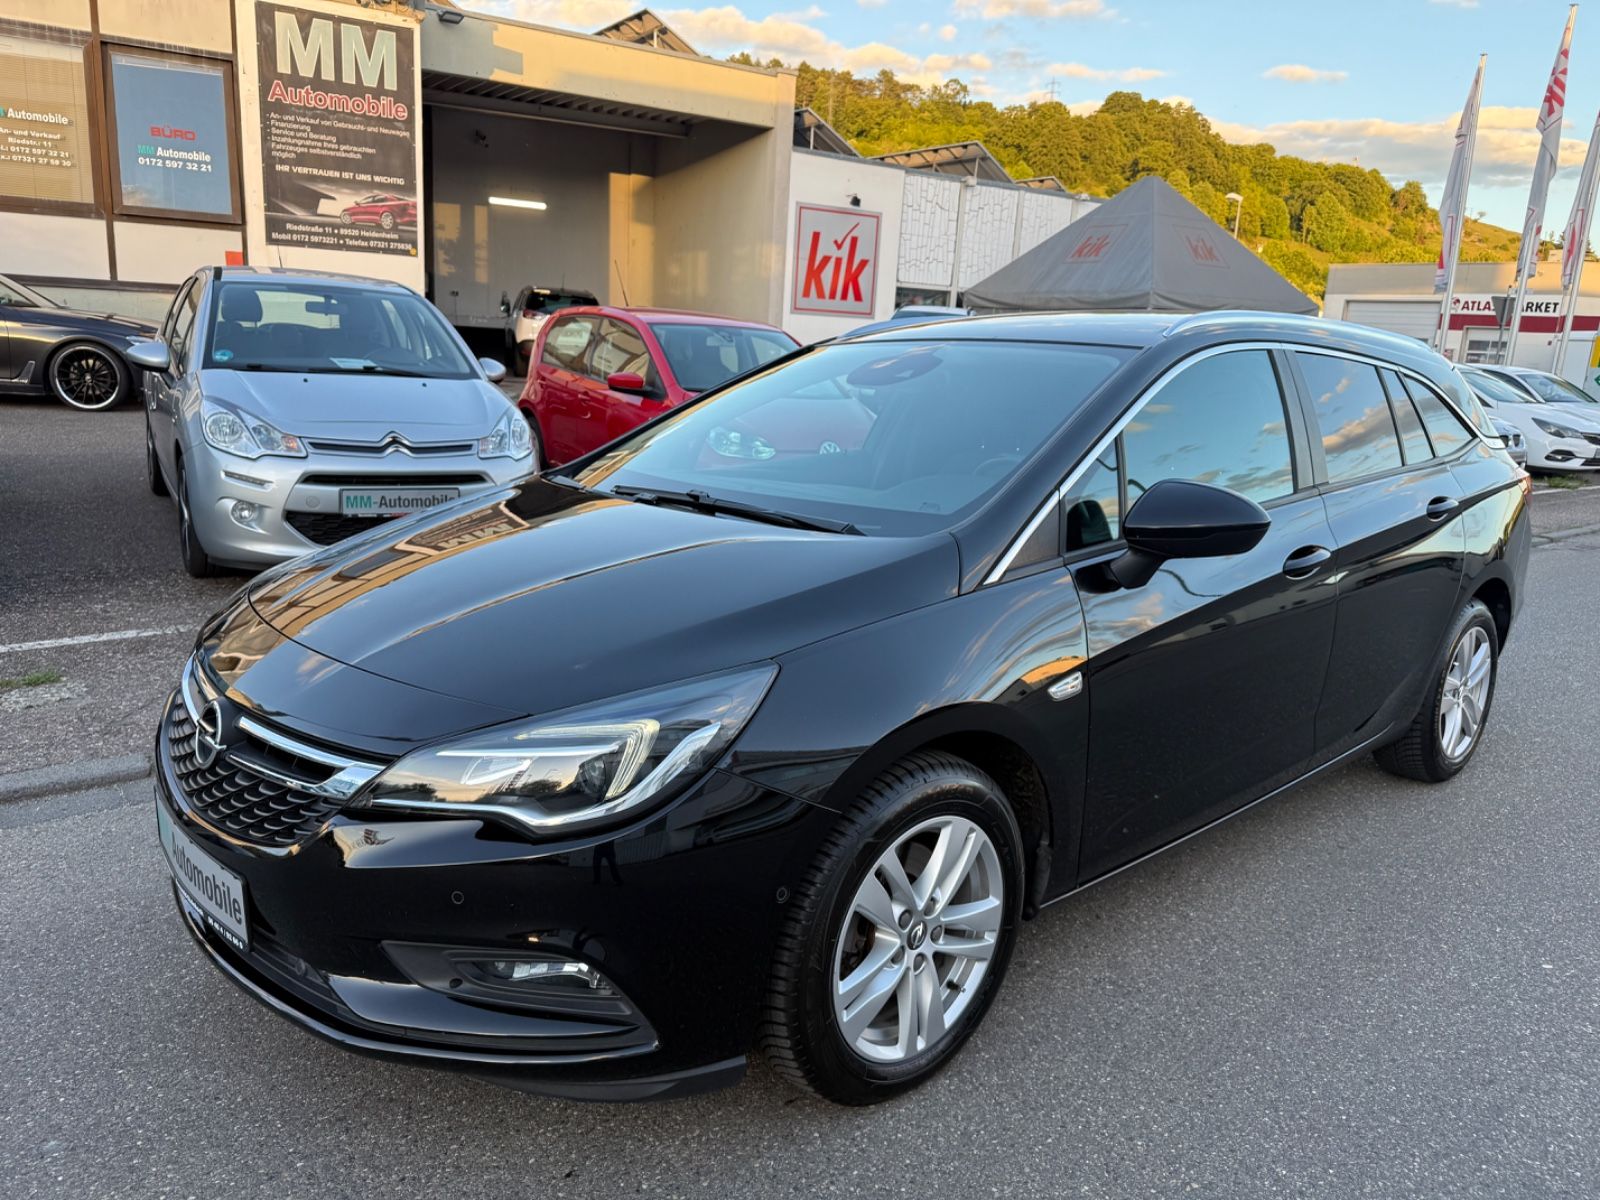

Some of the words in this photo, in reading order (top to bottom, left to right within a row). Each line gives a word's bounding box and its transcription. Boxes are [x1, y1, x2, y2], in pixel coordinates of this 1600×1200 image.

[274, 11, 398, 91] MM
[267, 80, 409, 120] Automobile
[7, 107, 69, 125] Automobile
[296, 115, 319, 124] Verkauf
[150, 124, 196, 141] BÜRO
[271, 120, 311, 132] Finanzierung
[13, 129, 29, 137] und
[29, 130, 61, 140] Verkauf
[271, 127, 295, 137] Service
[309, 131, 337, 142] Beratung
[10, 146, 30, 154] 0172
[137, 144, 155, 155] MM
[156, 146, 212, 163] Automobile
[271, 141, 308, 153] Fahrzeuges
[271, 150, 297, 159] möglich
[11, 155, 36, 164] 07321
[37, 157, 49, 165] 27
[138, 156, 163, 167] 0172
[165, 160, 183, 169] 597
[186, 162, 199, 171] 32
[200, 163, 212, 173] 21
[275, 164, 290, 173] IHR
[291, 165, 340, 178] VERTRAUEN
[342, 171, 354, 179] IST
[355, 173, 372, 182] UNS
[373, 175, 405, 186] WICHTIG
[271, 232, 291, 240] Mobil
[292, 233, 309, 242] 0172
[344, 238, 369, 247] Telefax
[286, 223, 324, 233] Riedstraße
[325, 226, 333, 234] 11
[360, 229, 399, 240] Heidenheim
[1071, 234, 1111, 257] kik
[802, 224, 870, 303] kik
[1461, 300, 1495, 312] ATLA
